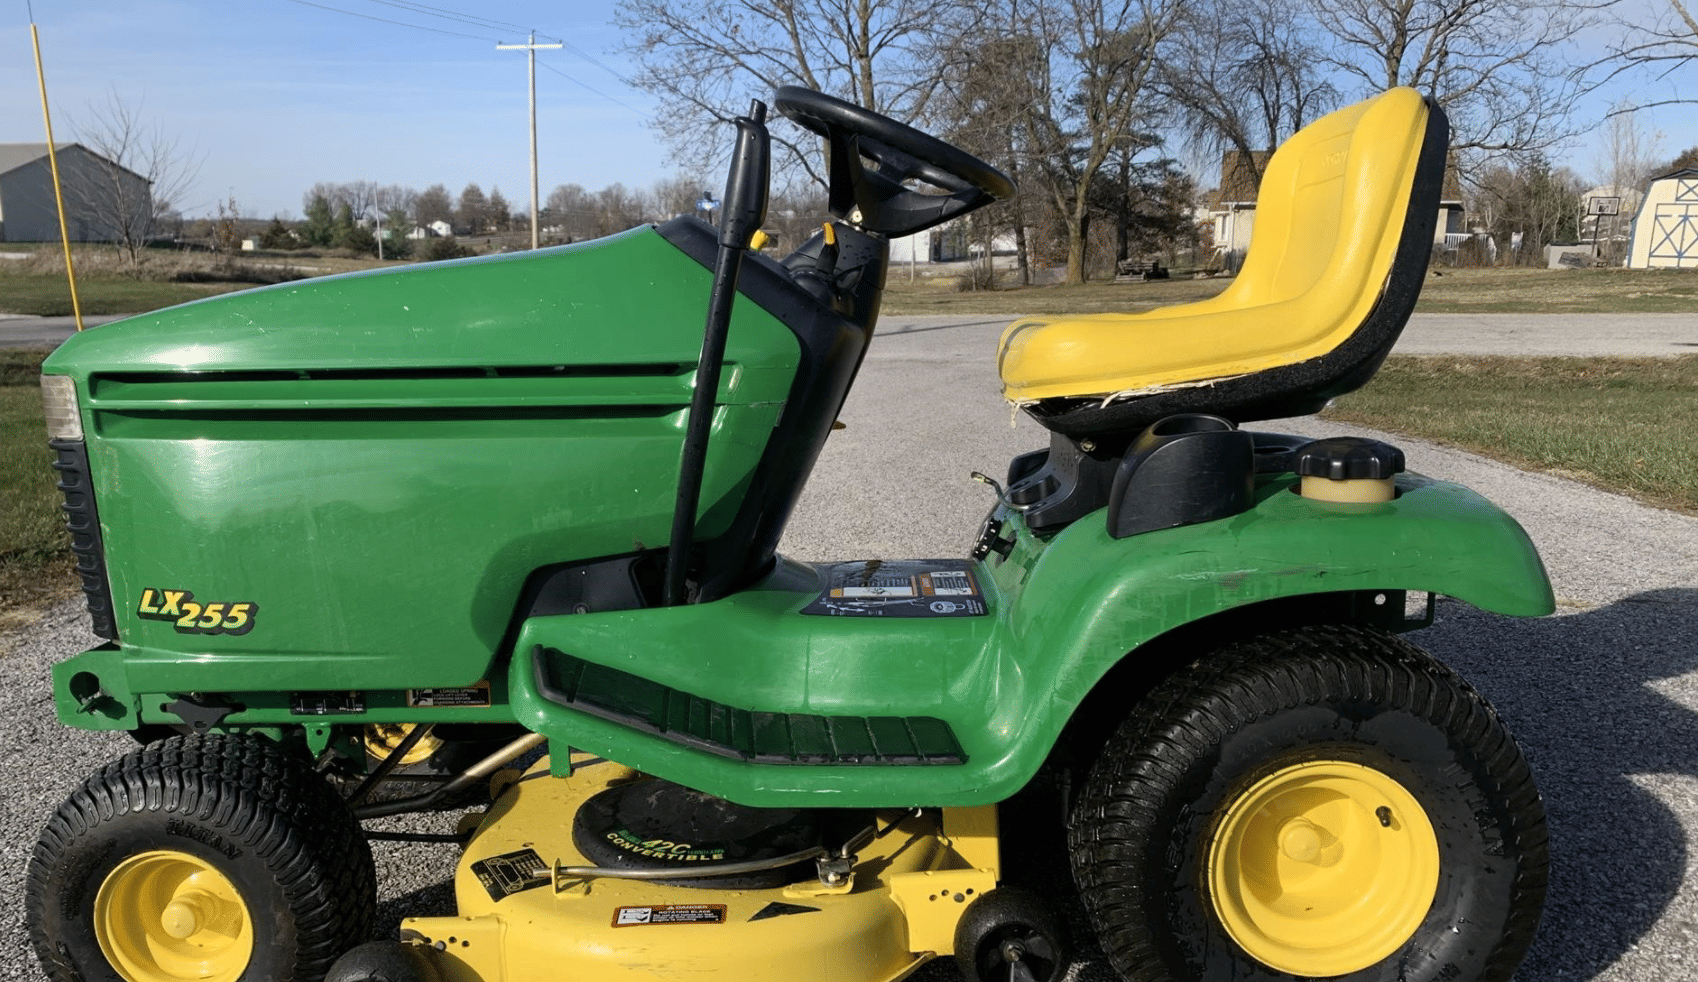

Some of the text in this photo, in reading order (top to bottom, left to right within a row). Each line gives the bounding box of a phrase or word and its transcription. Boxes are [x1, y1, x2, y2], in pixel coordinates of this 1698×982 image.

[138, 588, 254, 632] LX 255
[166, 818, 244, 860] TITAN
[606, 832, 723, 861] CONVERTIBLE
[641, 839, 692, 855] 42C
